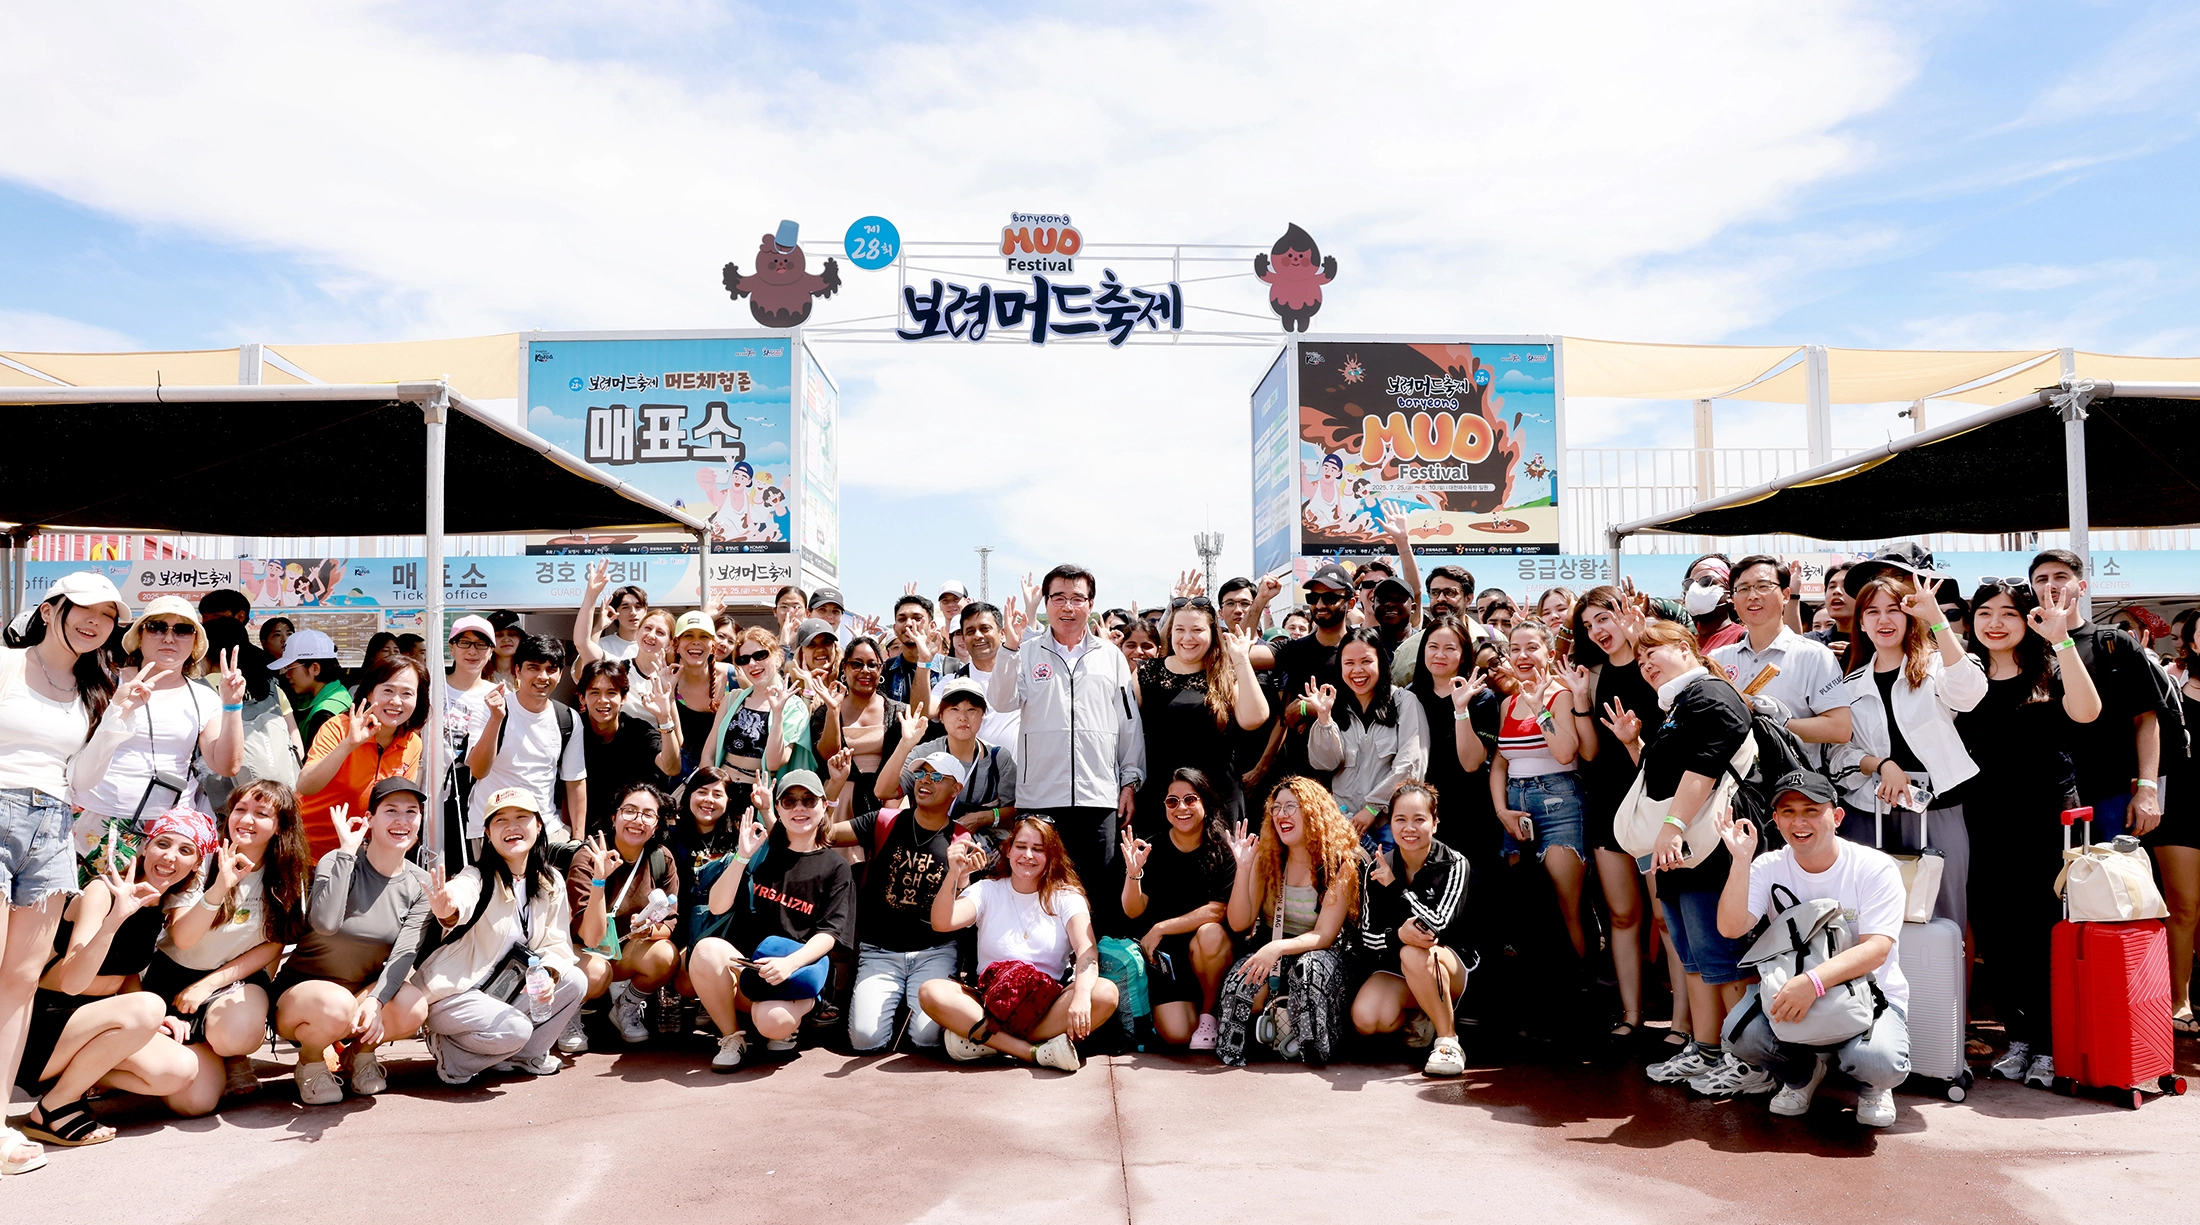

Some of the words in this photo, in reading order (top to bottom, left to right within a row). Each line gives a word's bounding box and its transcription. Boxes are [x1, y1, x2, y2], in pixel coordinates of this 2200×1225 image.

[863, 224, 880, 234] 제
[851, 237, 893, 260] 28회
[1002, 227, 1081, 256] MUD
[1008, 257, 1073, 272] Festival
[898, 269, 1182, 346] 보령머드축제
[588, 373, 659, 393] 보령머드축제
[664, 371, 752, 393] 머드체험존
[1386, 374, 1469, 398] 보령머드축제
[587, 404, 744, 464] 매표소
[1362, 412, 1493, 463] MUD
[1399, 464, 1468, 480] Festival
[158, 568, 232, 588] 보령머드축제
[536, 562, 576, 583] 경호
[607, 561, 647, 582] 경비
[717, 562, 791, 582] 보령머드축제
[393, 590, 427, 600] Tick
[446, 590, 487, 600] office
[551, 588, 581, 596] GUARD
[2100, 581, 2131, 589] CENTER
[1819, 682, 1834, 695] PLAY
[263, 736, 275, 767] ALOMON
[899, 850, 935, 872] 사랑
[902, 872, 922, 888] 해
